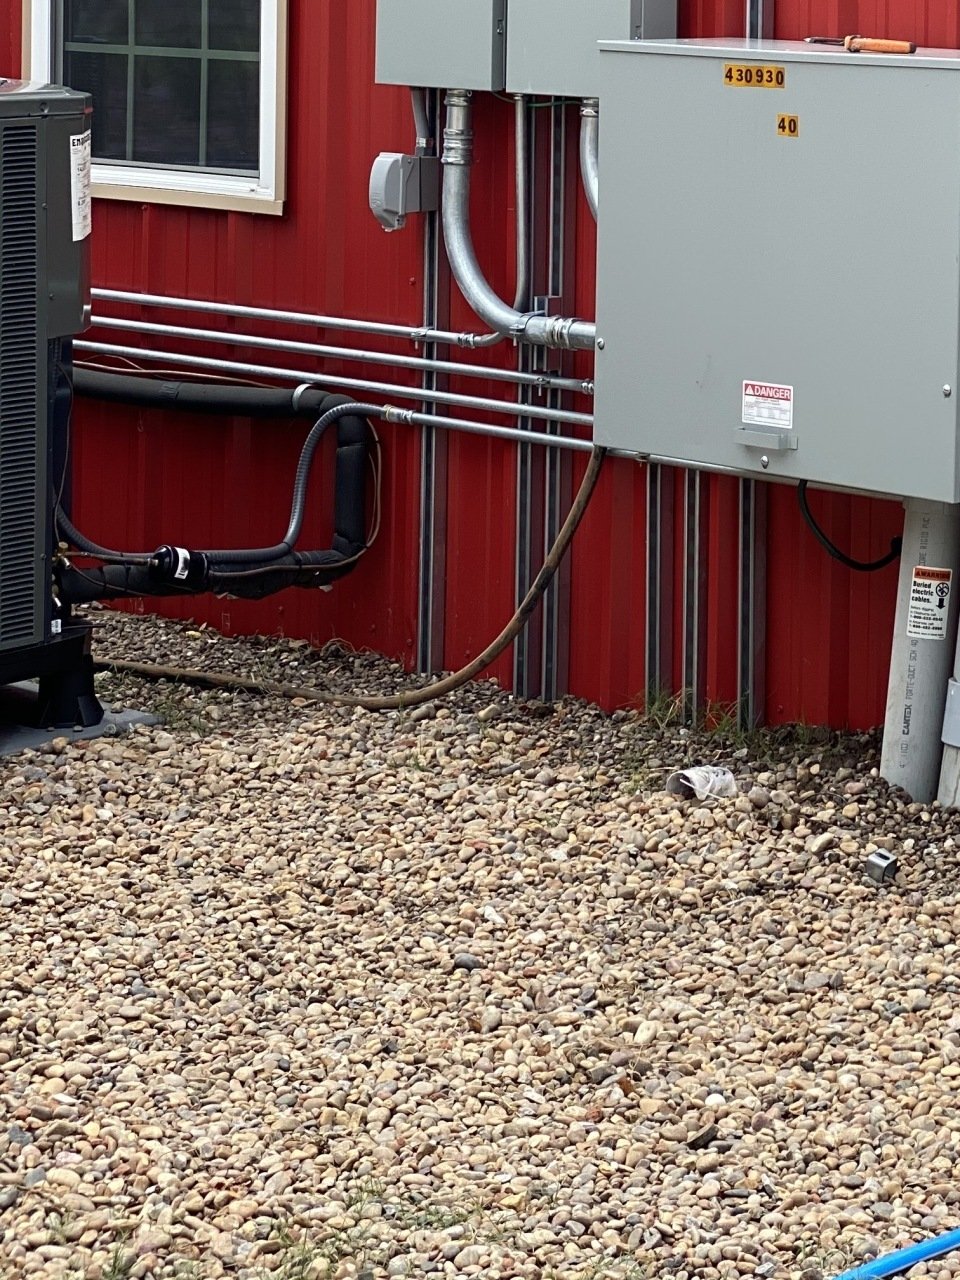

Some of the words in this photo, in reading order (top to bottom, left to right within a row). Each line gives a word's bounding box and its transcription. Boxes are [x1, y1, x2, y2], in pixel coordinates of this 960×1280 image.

[725, 67, 784, 86] 430930
[778, 118, 797, 133] 40
[754, 386, 790, 399] DANGER
[913, 581, 931, 589] Buried
[912, 588, 934, 596] electric
[911, 595, 932, 603] cables.
[902, 704, 912, 735] CANTEX
